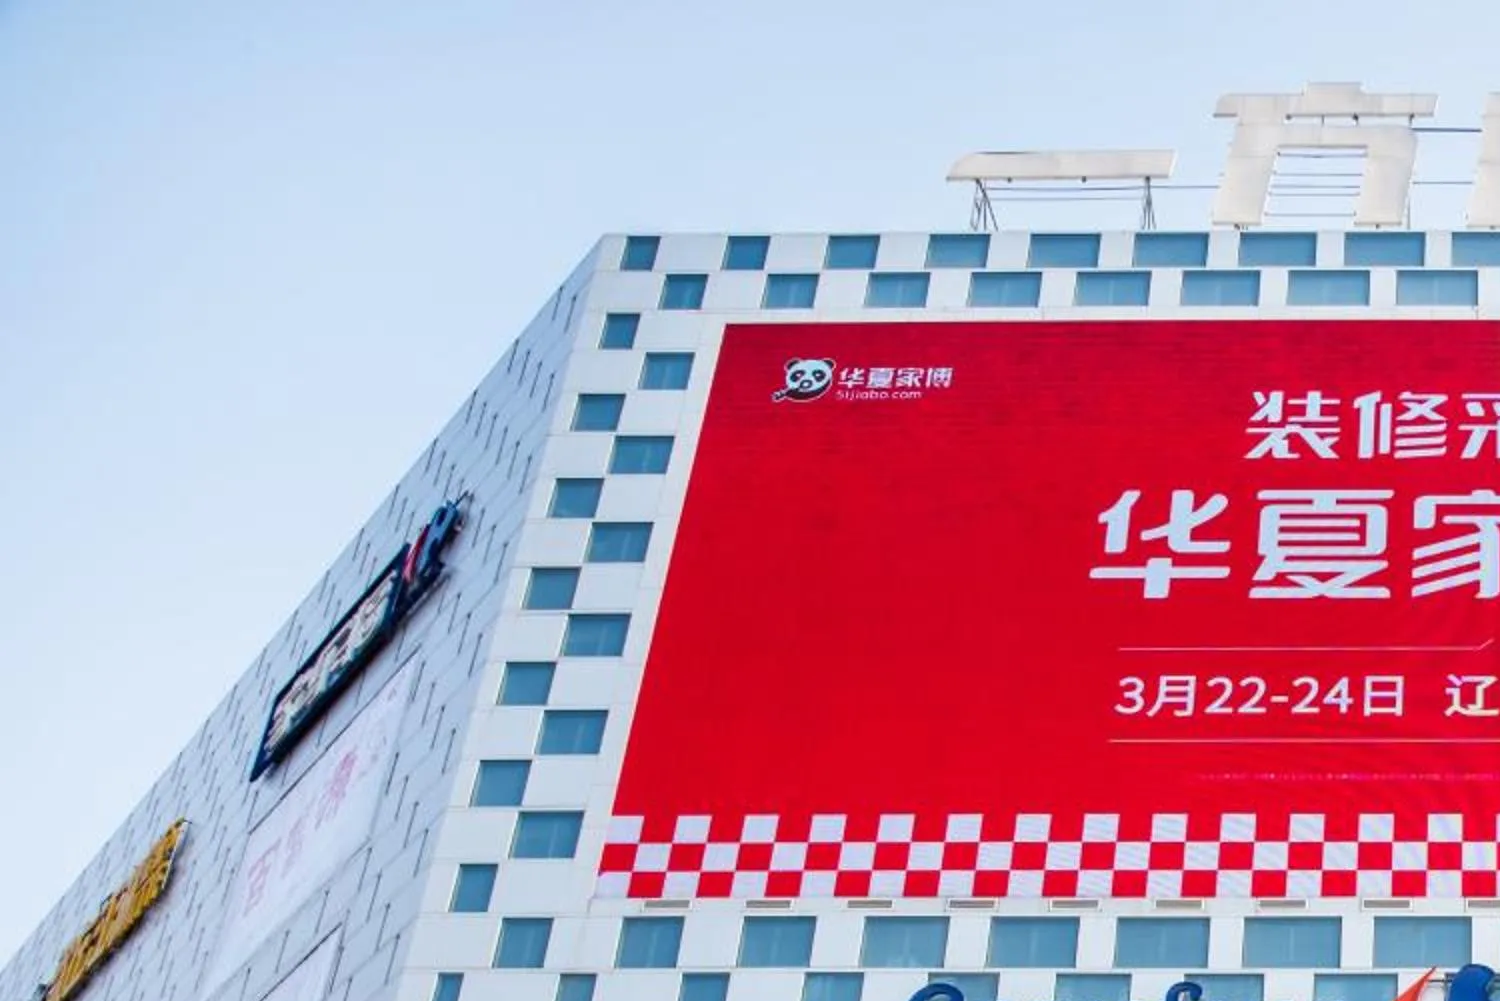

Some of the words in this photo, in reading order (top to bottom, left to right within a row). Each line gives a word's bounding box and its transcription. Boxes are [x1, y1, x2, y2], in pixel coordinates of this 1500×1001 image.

[838, 367, 954, 389] 华夏家博
[1114, 674, 1405, 718] 3月22-24日
